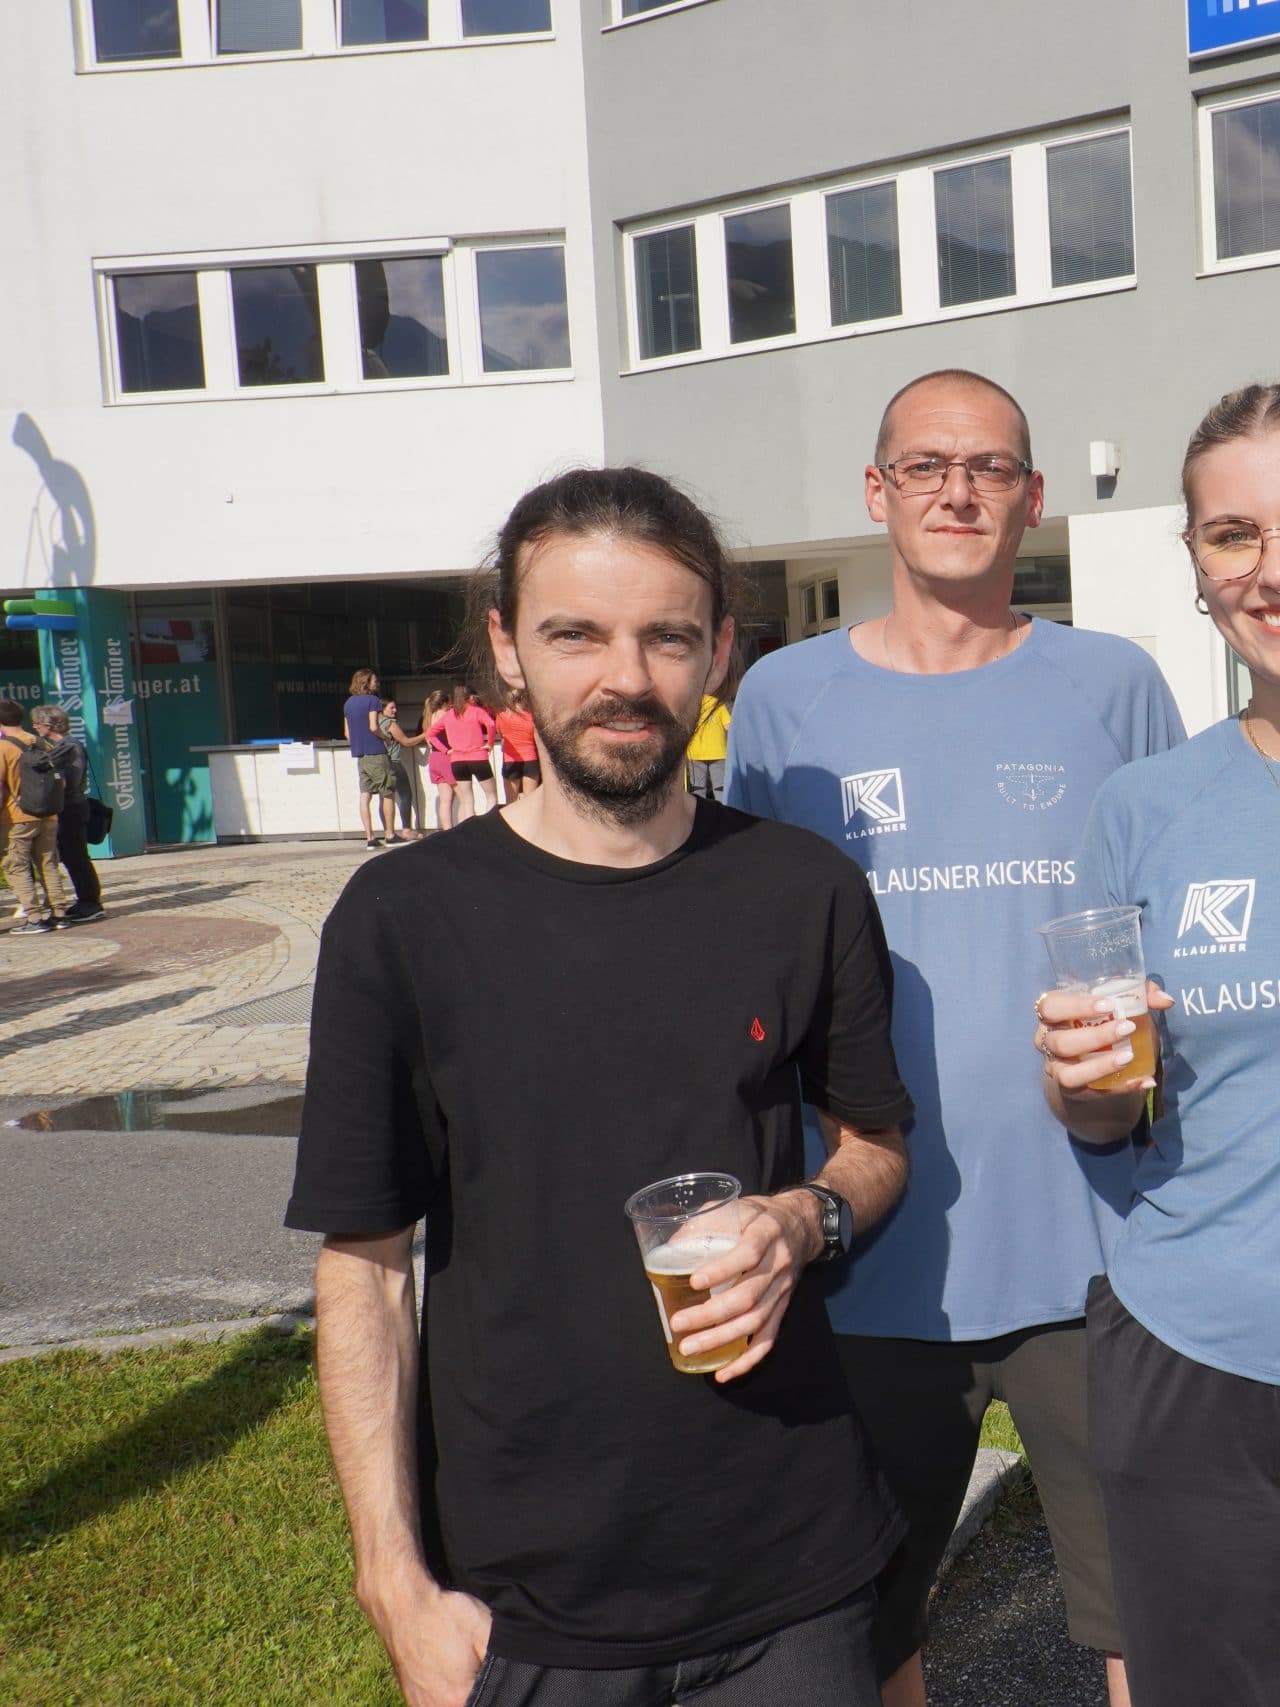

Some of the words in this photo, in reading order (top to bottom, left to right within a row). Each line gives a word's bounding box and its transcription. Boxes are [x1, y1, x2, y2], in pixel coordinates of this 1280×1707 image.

[996, 763, 1065, 773] PATAGONIA
[997, 782, 1016, 805] BUILT
[1040, 783, 1067, 810] ENDURE
[845, 822, 908, 840] KLAUSNER
[866, 864, 980, 894] LAUSNER
[985, 860, 1076, 887] KICKERS
[1173, 943, 1247, 958] KLAUSNER
